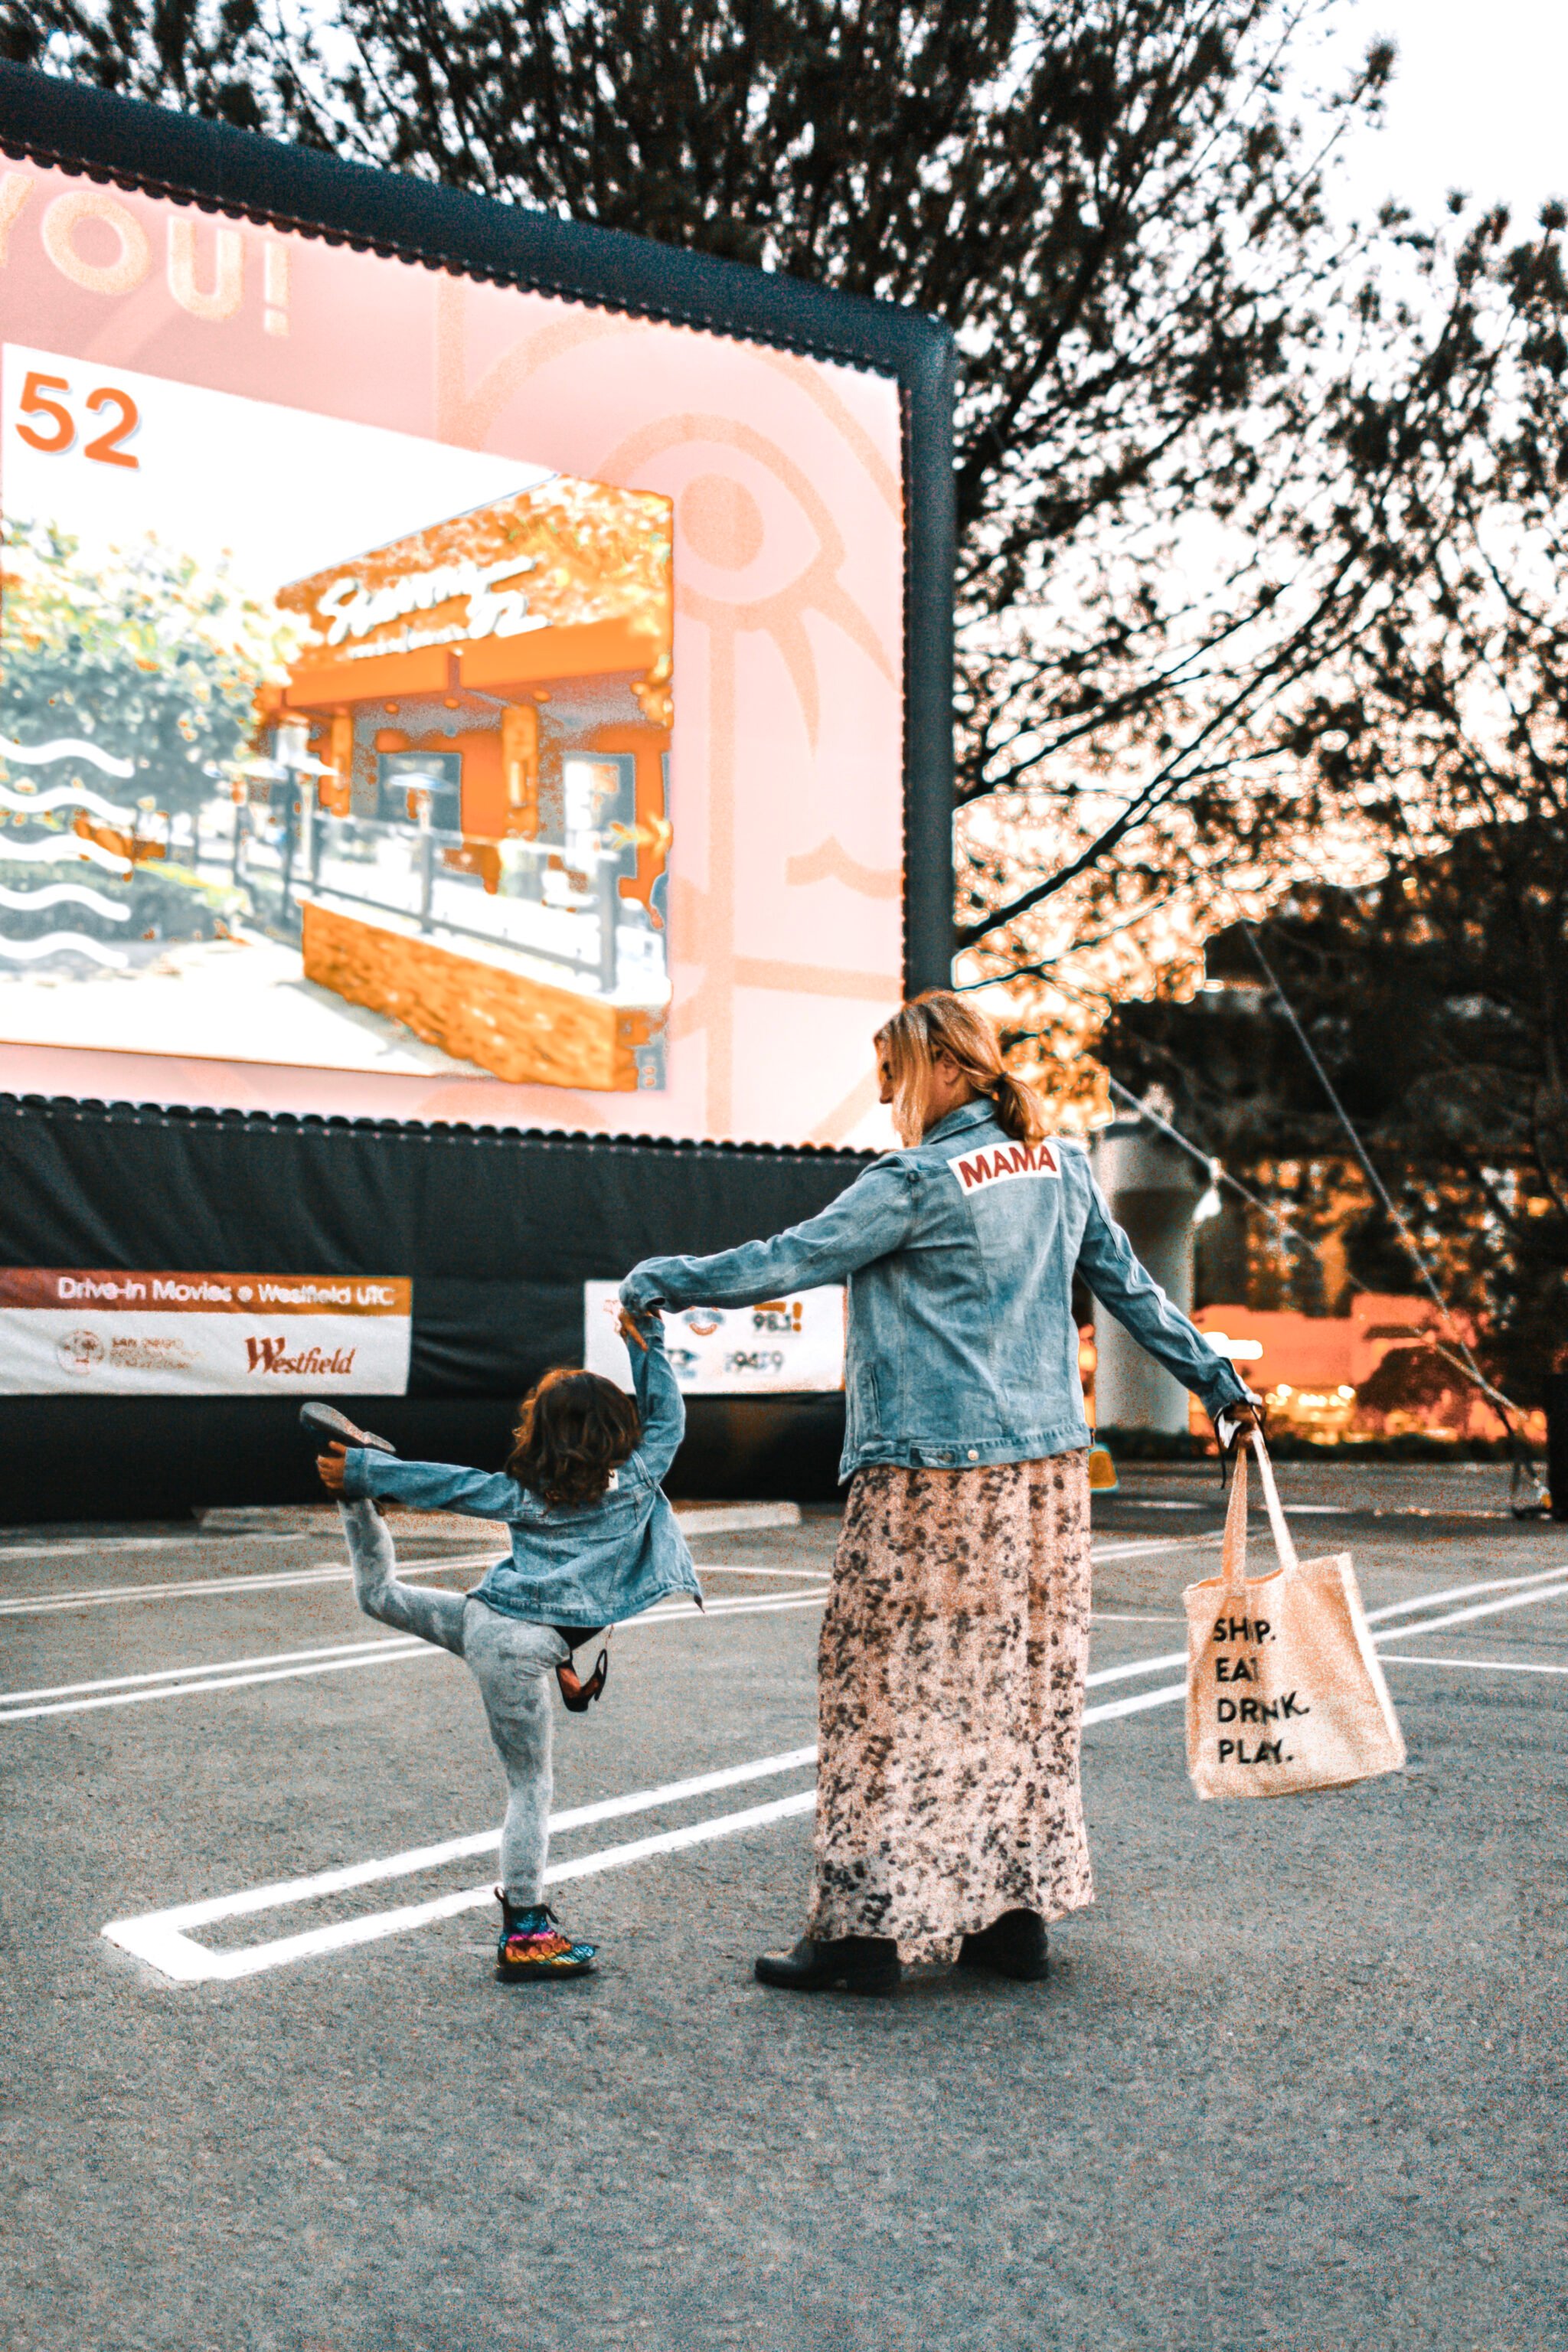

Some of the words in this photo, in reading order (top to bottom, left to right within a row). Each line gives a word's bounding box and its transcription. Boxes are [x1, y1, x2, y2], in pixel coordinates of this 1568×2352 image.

[15, 371, 140, 469] 52
[958, 1145, 1057, 1188] MAMA
[152, 1279, 232, 1302] Movies
[357, 1285, 395, 1306] UTC
[245, 1334, 356, 1375] Westfield
[1219, 1739, 1293, 1764] PLAY.
